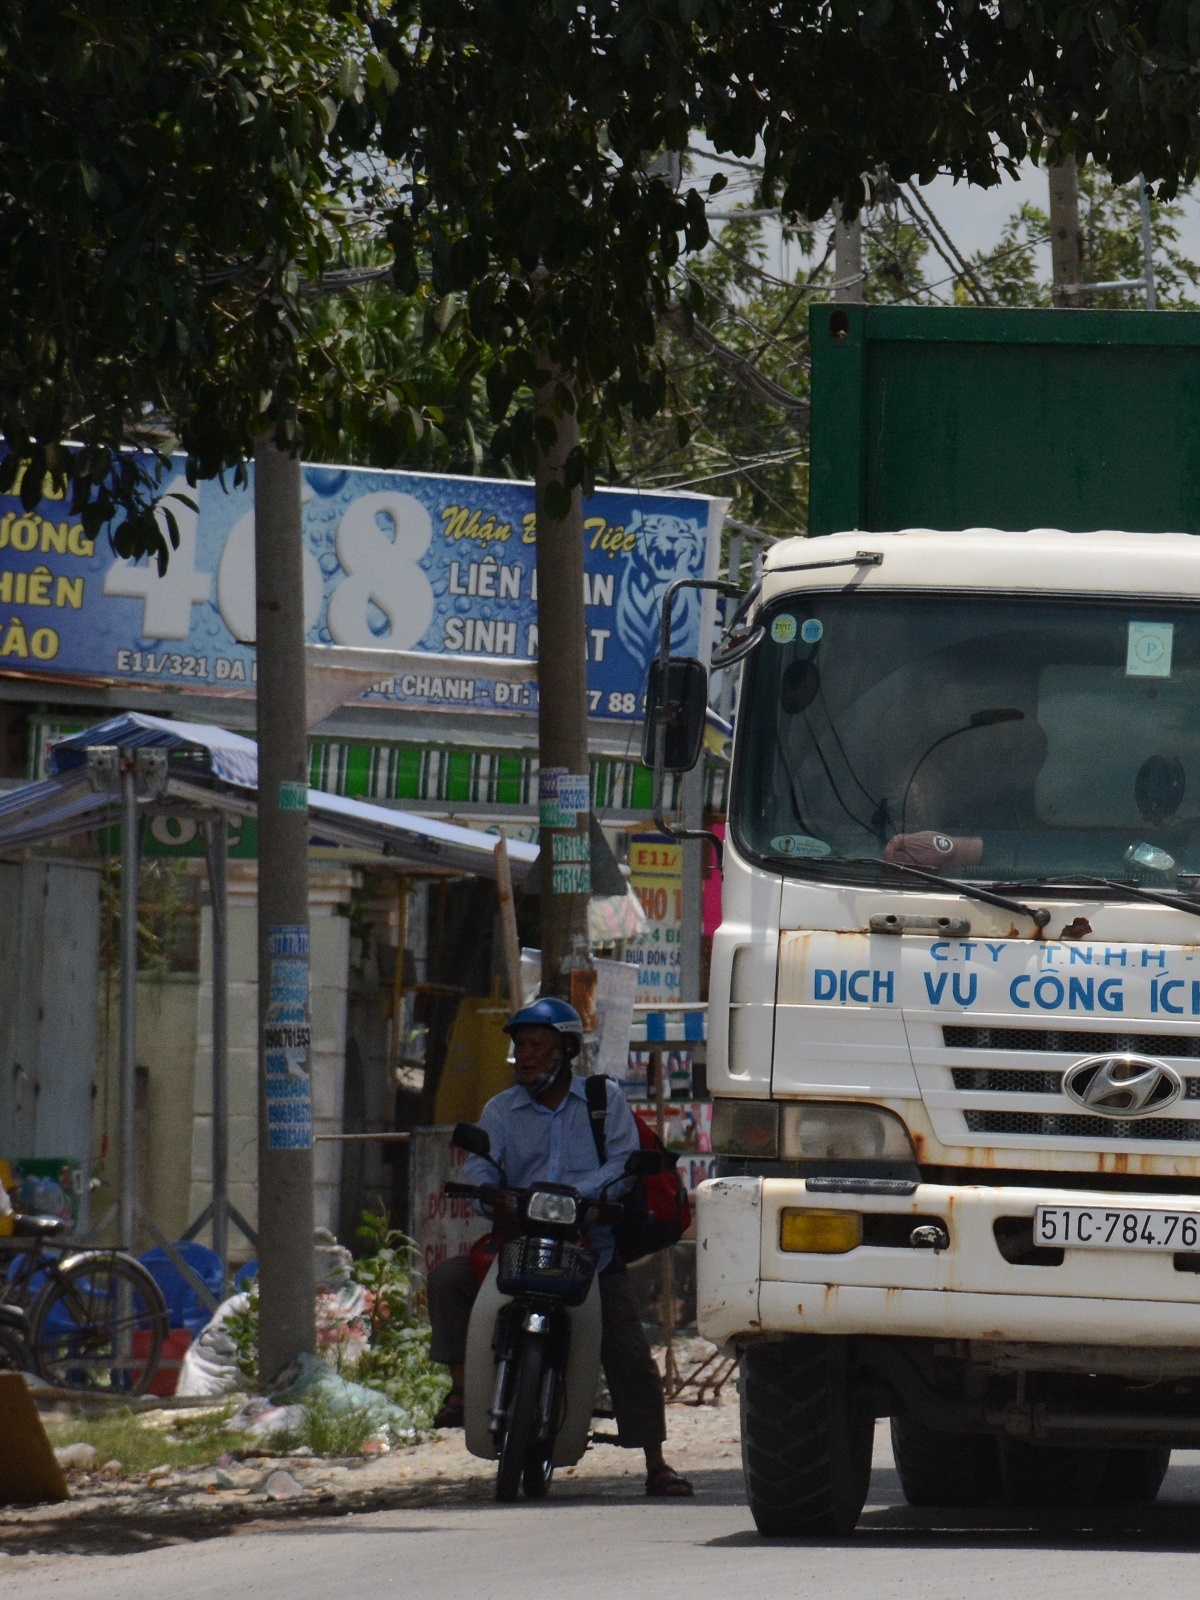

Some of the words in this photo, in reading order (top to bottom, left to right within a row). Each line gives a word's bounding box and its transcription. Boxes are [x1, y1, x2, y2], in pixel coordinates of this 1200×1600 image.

[441, 505, 512, 549] Nhận
[449, 556, 523, 600] LIÊN
[0, 616, 60, 660] ÀO
[444, 616, 518, 656] SINH
[117, 650, 209, 679] E11/321
[401, 675, 474, 701] CHANH
[608, 692, 636, 714] 88
[814, 968, 895, 1006] DỊCH
[923, 971, 978, 1010] VỤ
[1009, 968, 1124, 1013] CÔNG
[1041, 1209, 1199, 1247] 51C-784.76
